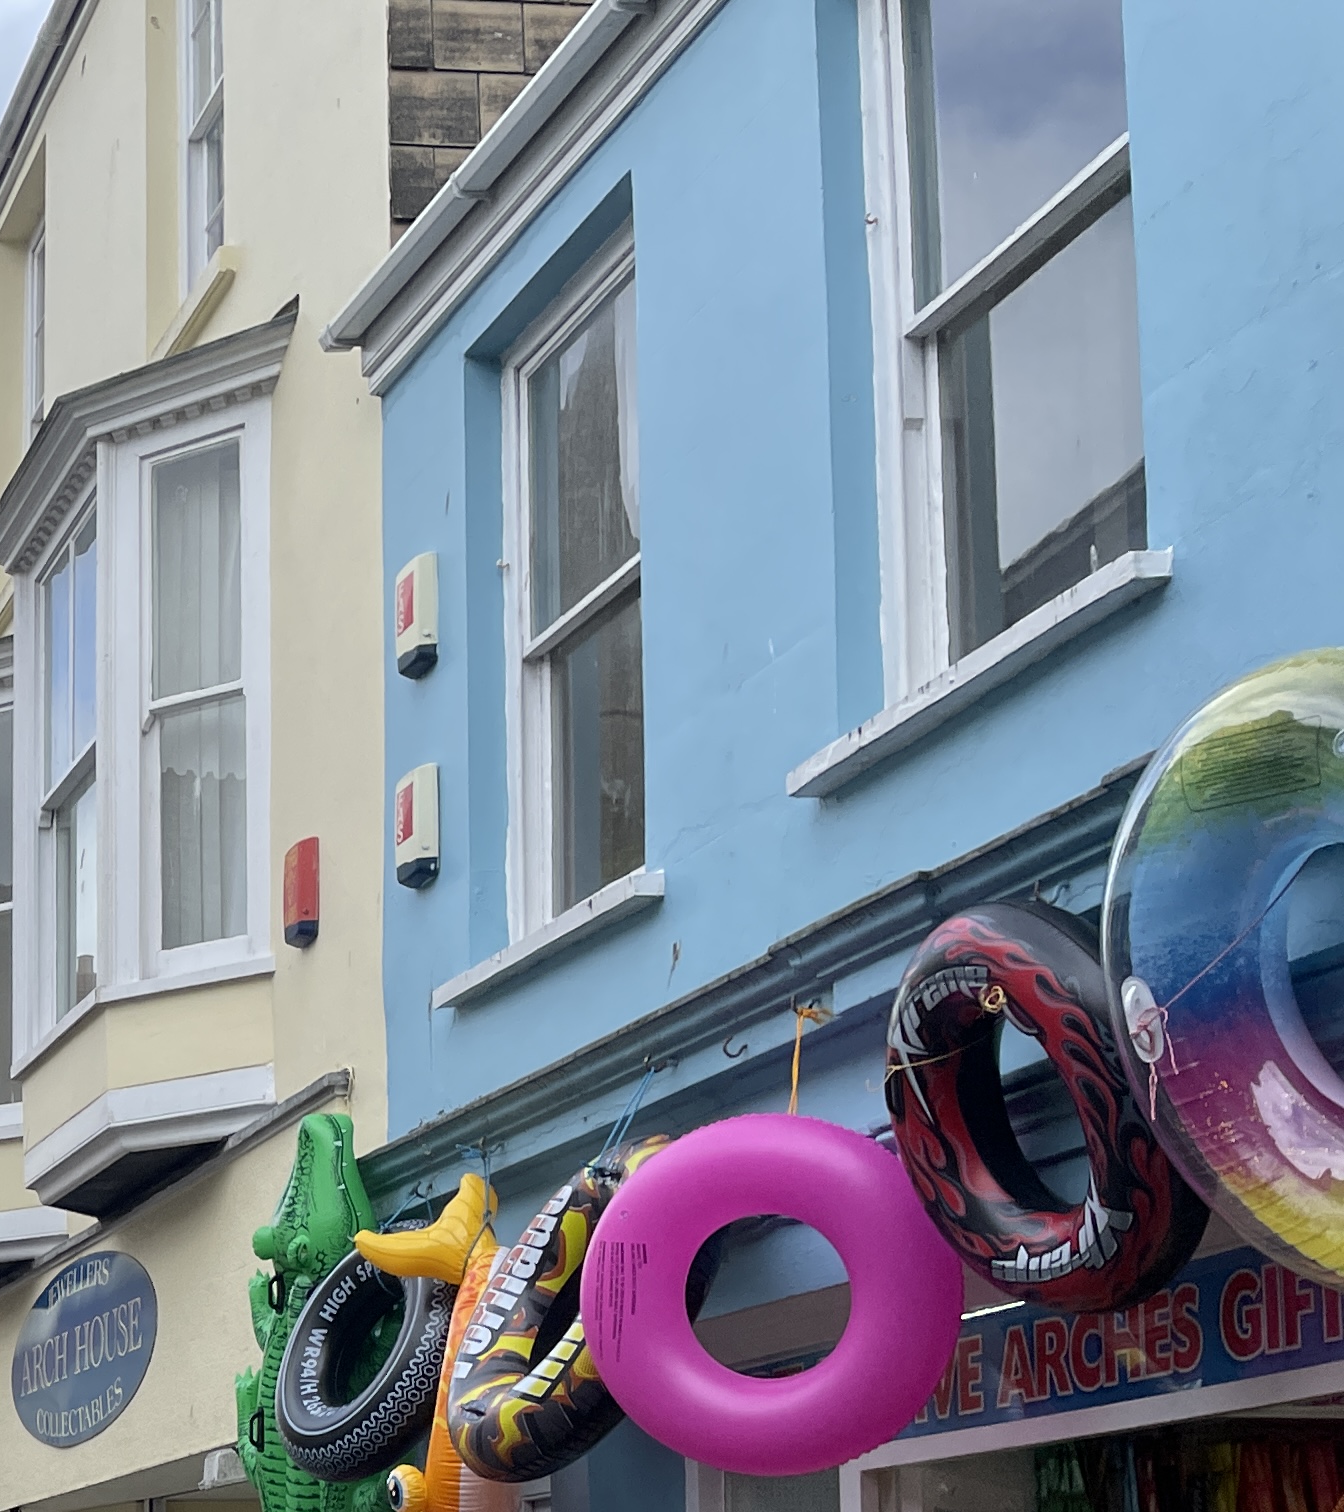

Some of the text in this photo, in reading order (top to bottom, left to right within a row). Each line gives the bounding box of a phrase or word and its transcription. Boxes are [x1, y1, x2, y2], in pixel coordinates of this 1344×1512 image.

[47, 1258, 110, 1314] JEWELLERS
[319, 1276, 357, 1322] HIGH
[20, 1297, 142, 1398] ARCH HOUSE
[916, 1335, 984, 1424] VE
[997, 1284, 1203, 1410] ARCHES
[36, 1377, 123, 1437] COLLECTABLES
